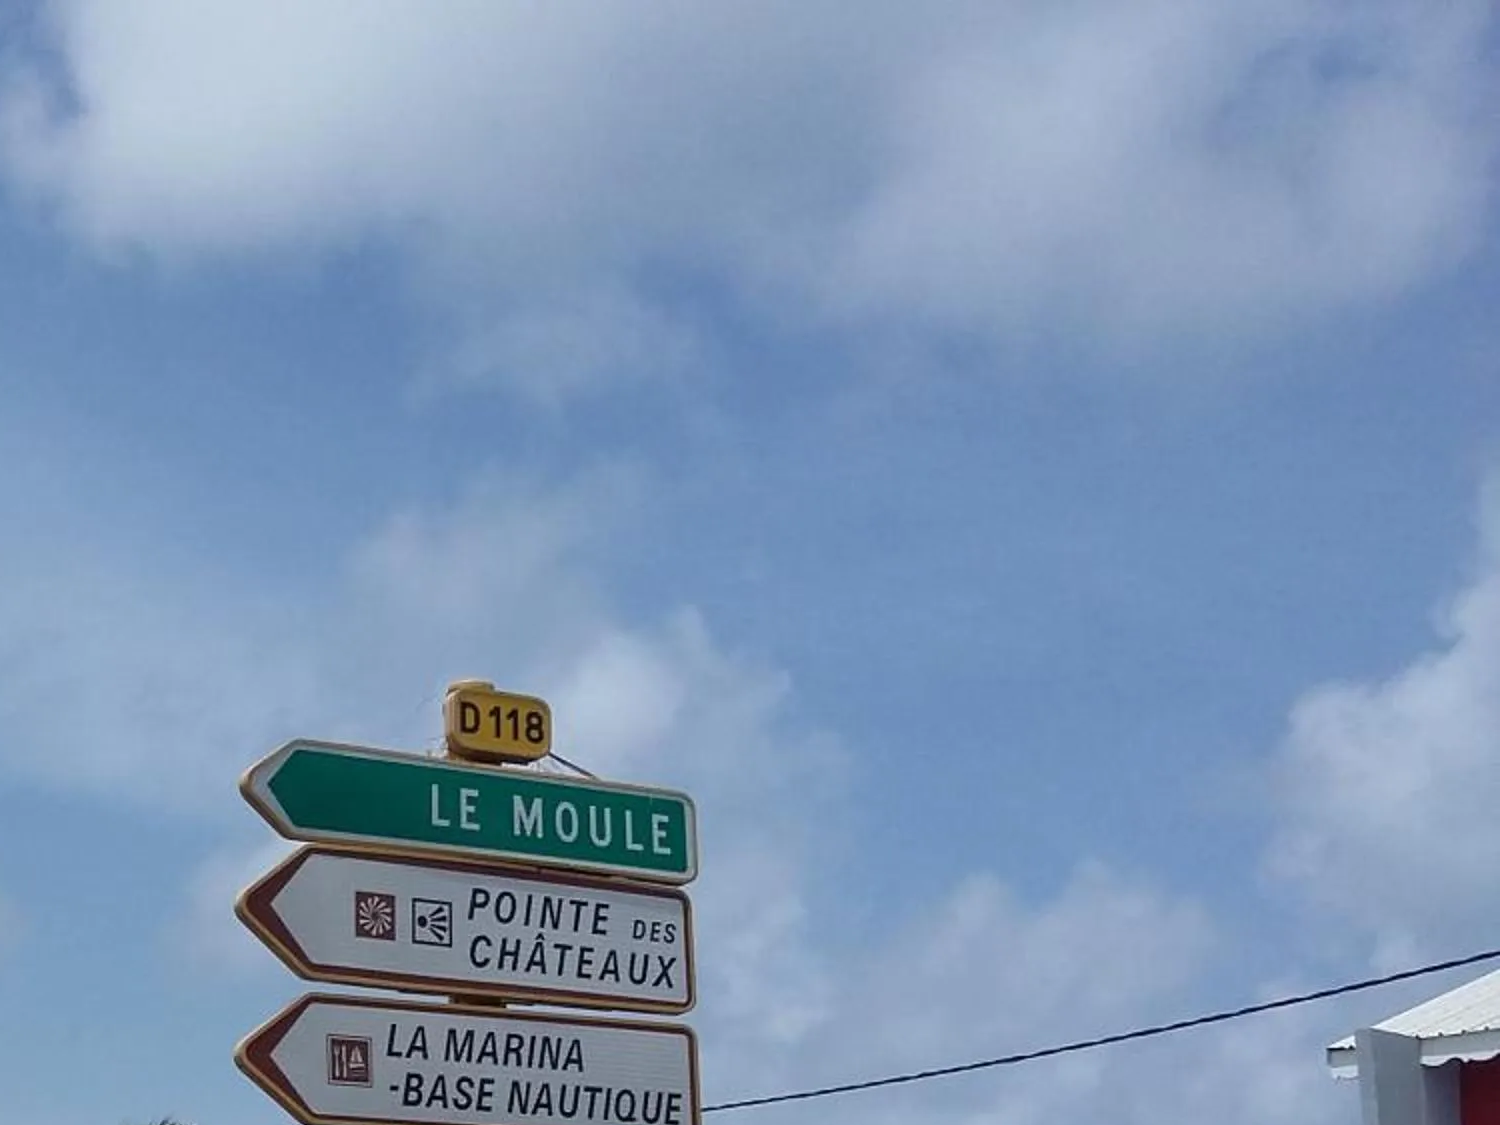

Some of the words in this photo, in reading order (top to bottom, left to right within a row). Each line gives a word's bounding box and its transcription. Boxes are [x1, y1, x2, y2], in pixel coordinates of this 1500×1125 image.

[431, 783, 480, 831] LE
[513, 795, 672, 855] MOULE
[468, 887, 610, 938] POINTE
[632, 918, 677, 944] DES
[469, 932, 678, 989] CHÂTEAUX
[386, 1023, 429, 1061] LA
[444, 1028, 585, 1073] MARINA
[507, 1079, 682, 1125] NAUTIQUE
